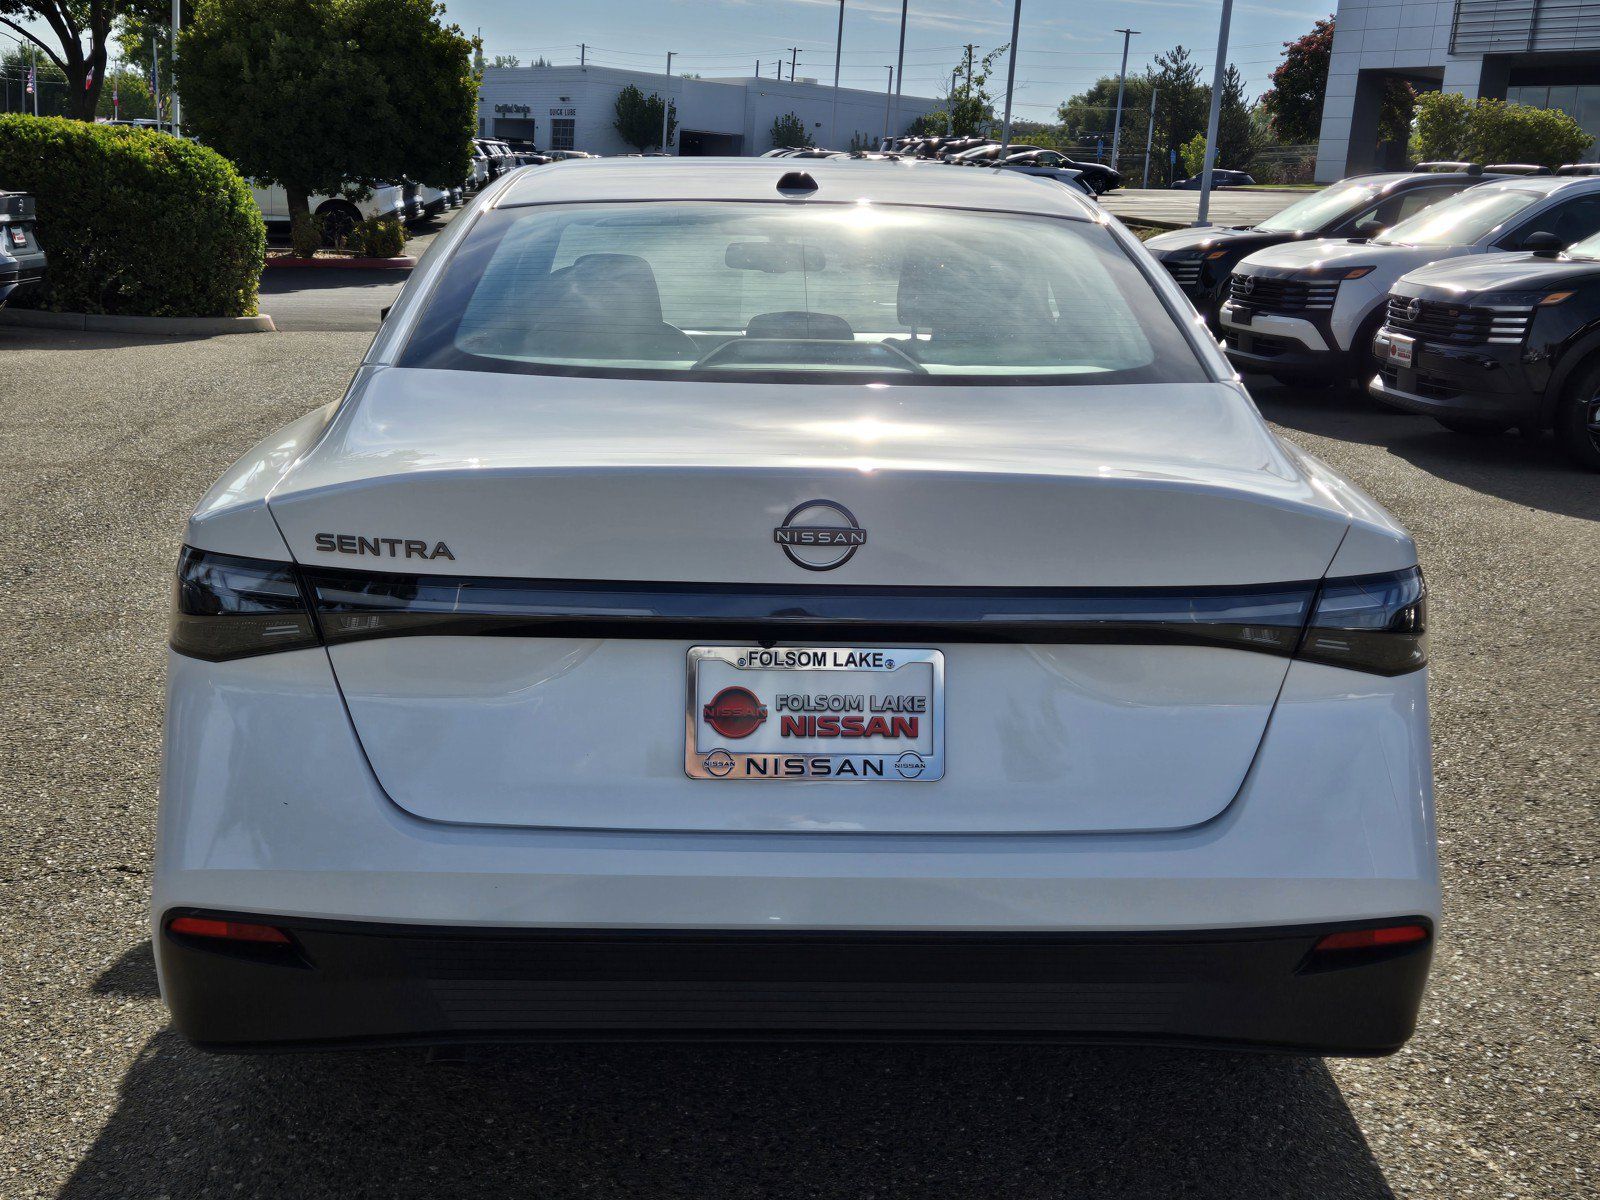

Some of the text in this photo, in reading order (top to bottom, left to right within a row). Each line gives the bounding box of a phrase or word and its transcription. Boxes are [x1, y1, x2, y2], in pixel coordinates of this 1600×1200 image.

[549, 108, 577, 116] QUICK LUBE
[776, 530, 864, 543] NISSAN
[314, 532, 456, 561] SENTRA
[748, 651, 884, 668] FOLSOM LAKE
[703, 705, 768, 718] NISSAN
[775, 693, 926, 713] FOLSOM LAKE
[780, 715, 919, 738] NISSAN
[746, 757, 884, 776] NISSAN
